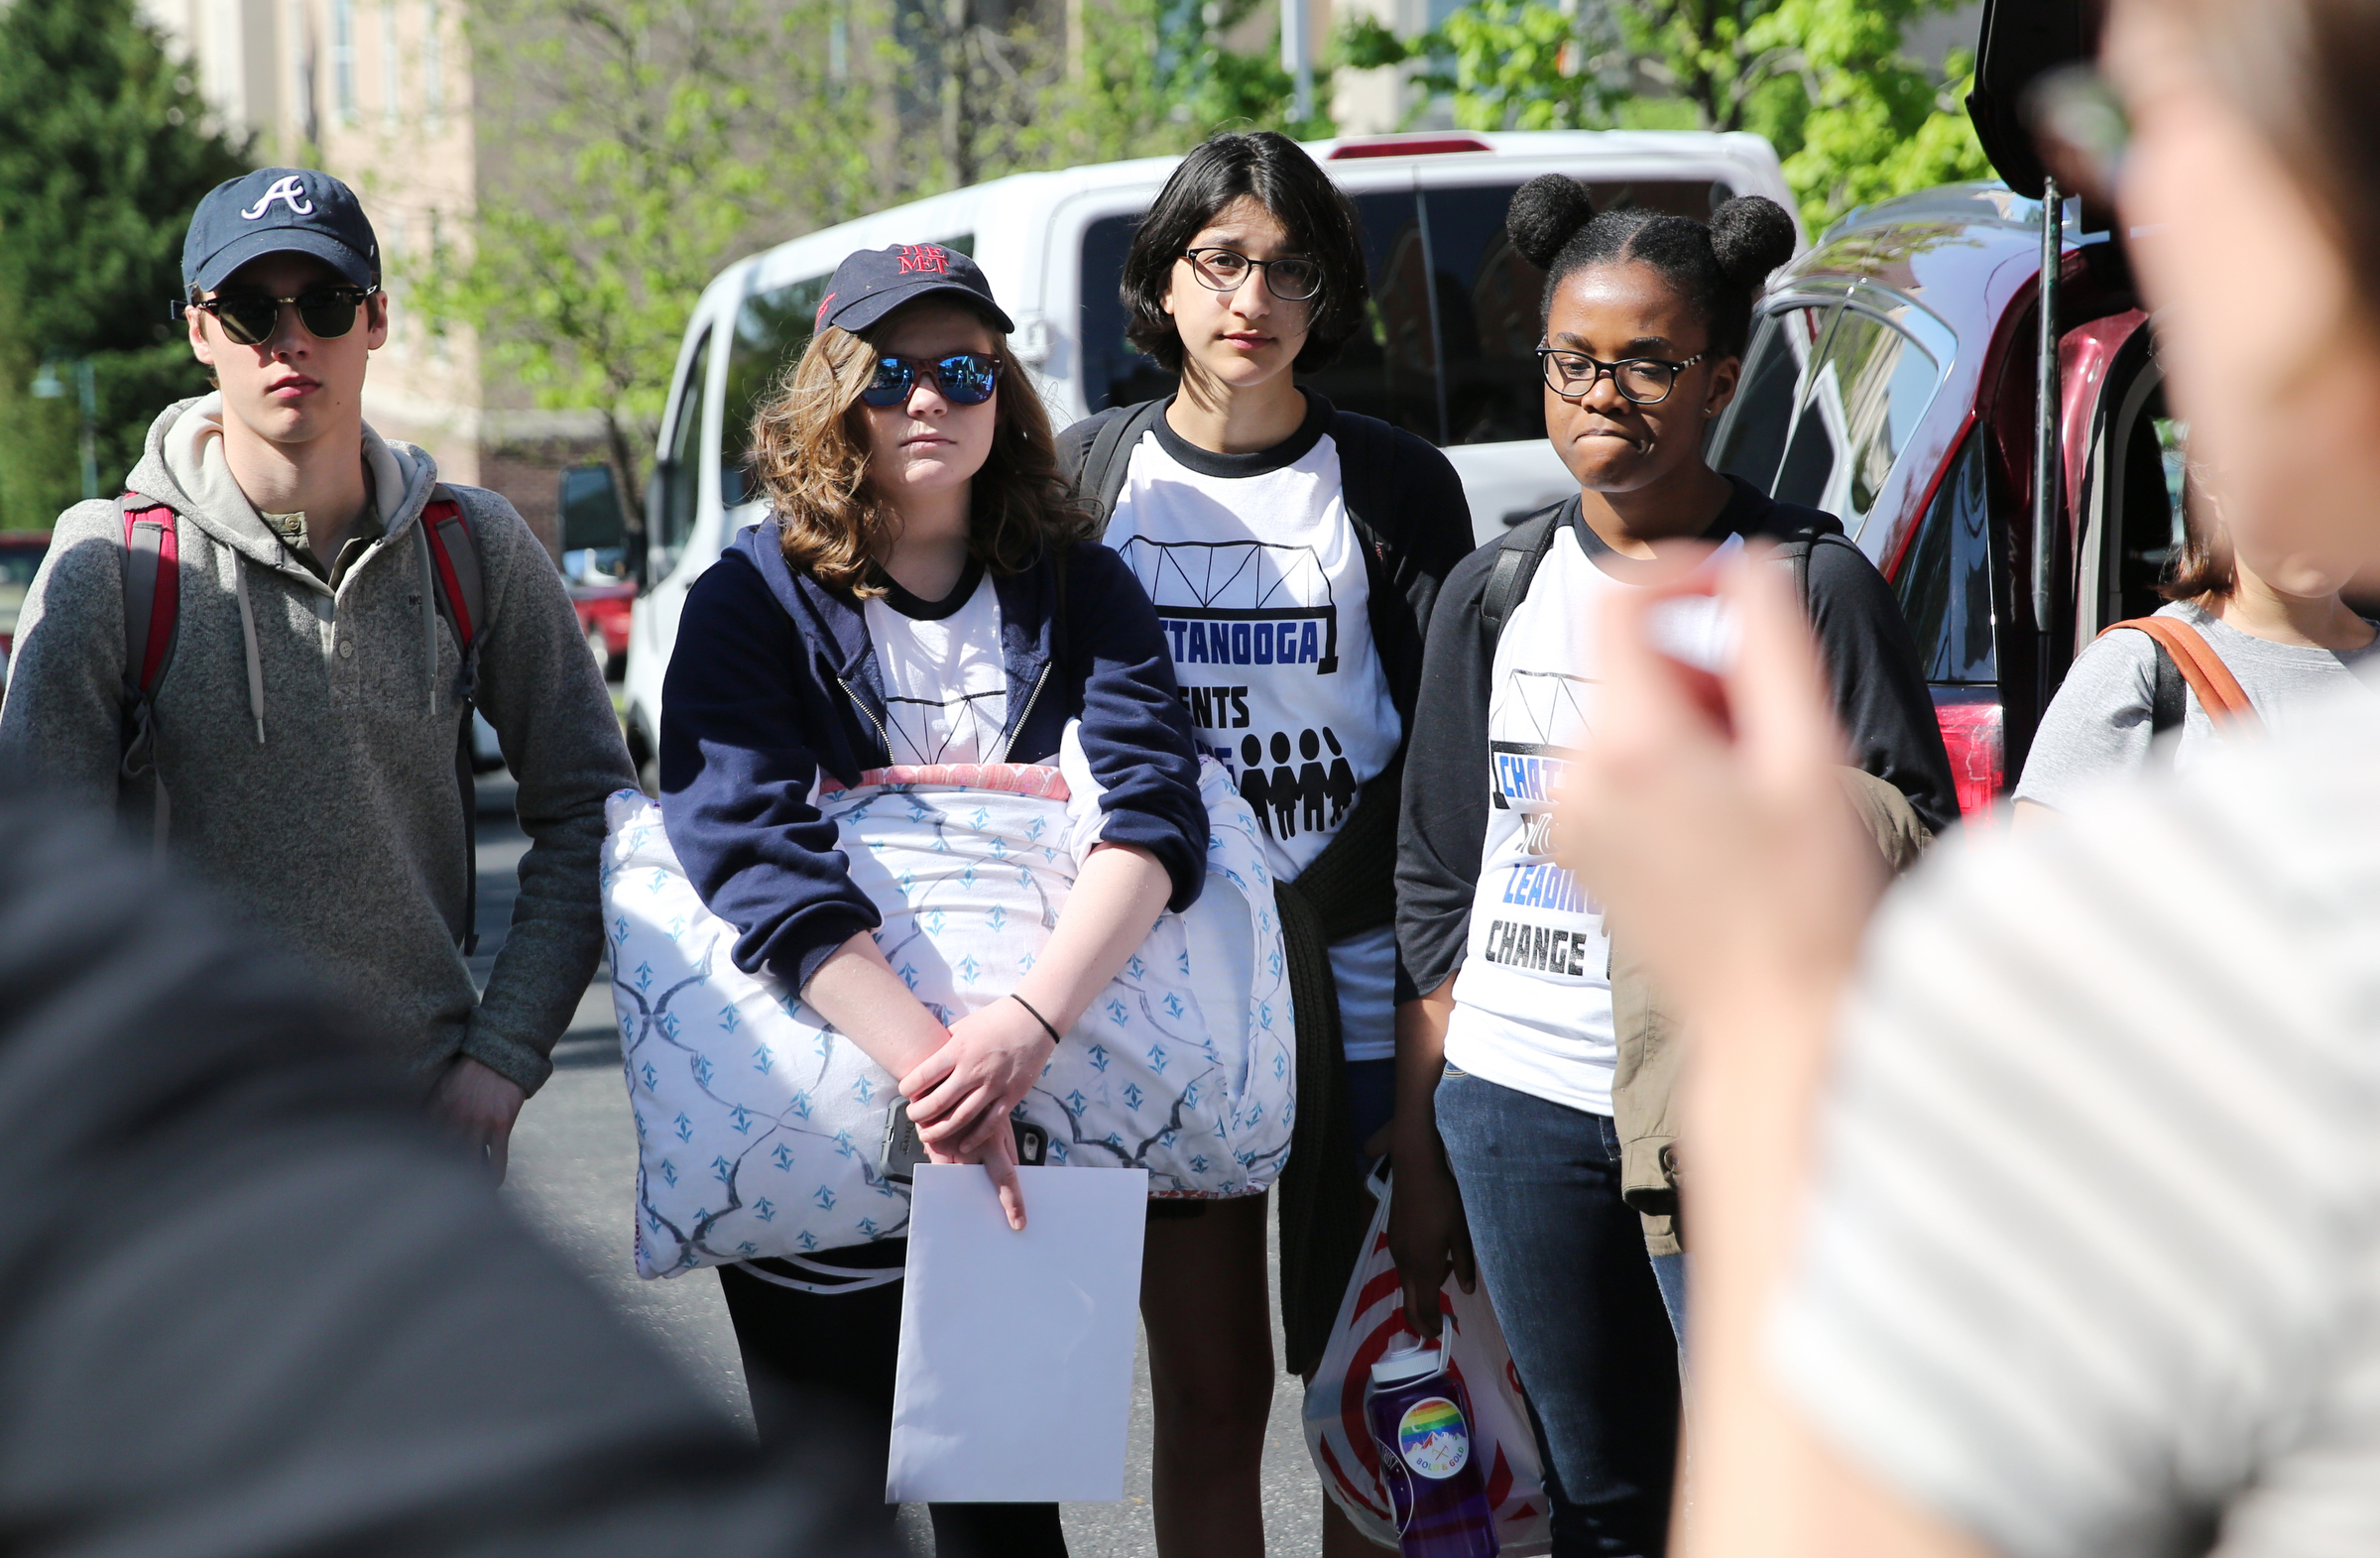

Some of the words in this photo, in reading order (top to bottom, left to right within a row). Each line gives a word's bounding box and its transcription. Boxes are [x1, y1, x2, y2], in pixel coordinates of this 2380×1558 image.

[895, 254, 950, 275] MET
[1486, 919, 1588, 976] CHANGE
[1416, 1457, 1439, 1472] BOLD
[1449, 1446, 1465, 1468] GOLD
